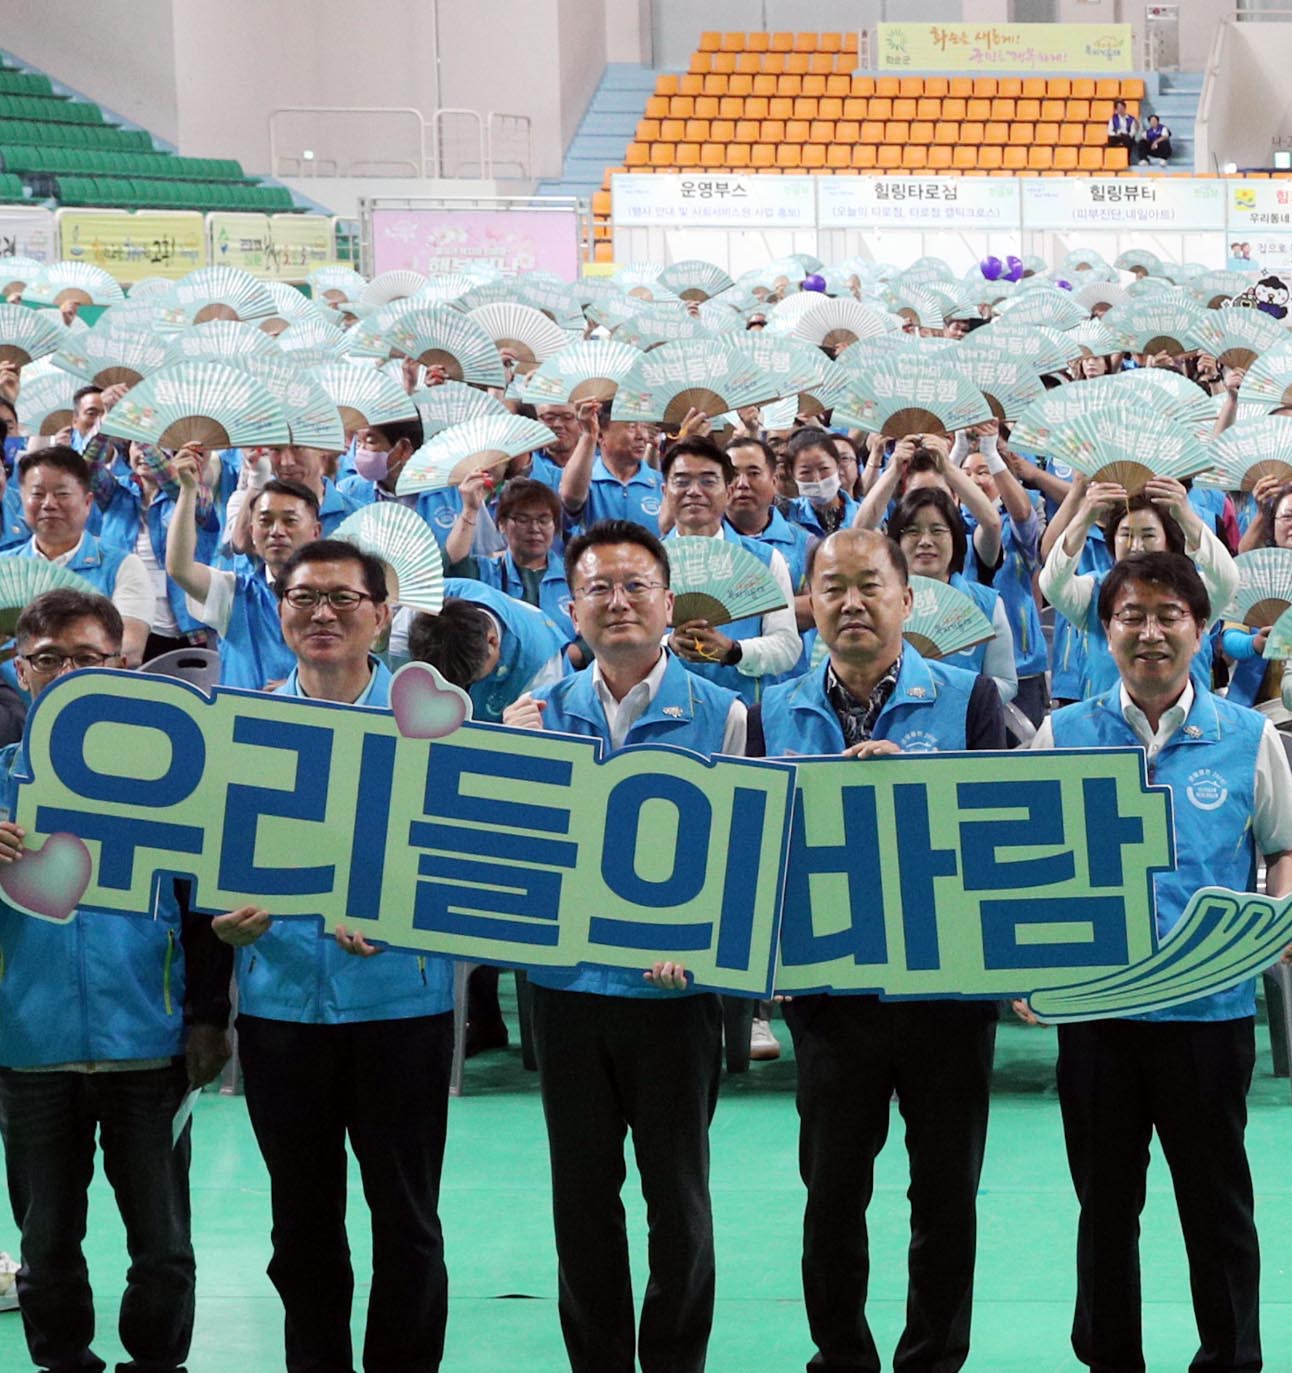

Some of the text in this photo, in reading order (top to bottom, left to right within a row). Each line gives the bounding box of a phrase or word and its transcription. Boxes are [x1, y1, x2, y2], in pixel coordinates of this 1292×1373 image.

[680, 181, 748, 199] 운영부스
[1090, 185, 1156, 202] 힐링뷰티
[1250, 212, 1290, 224] 우리동네
[37, 692, 1143, 970] 우리들의 바람
